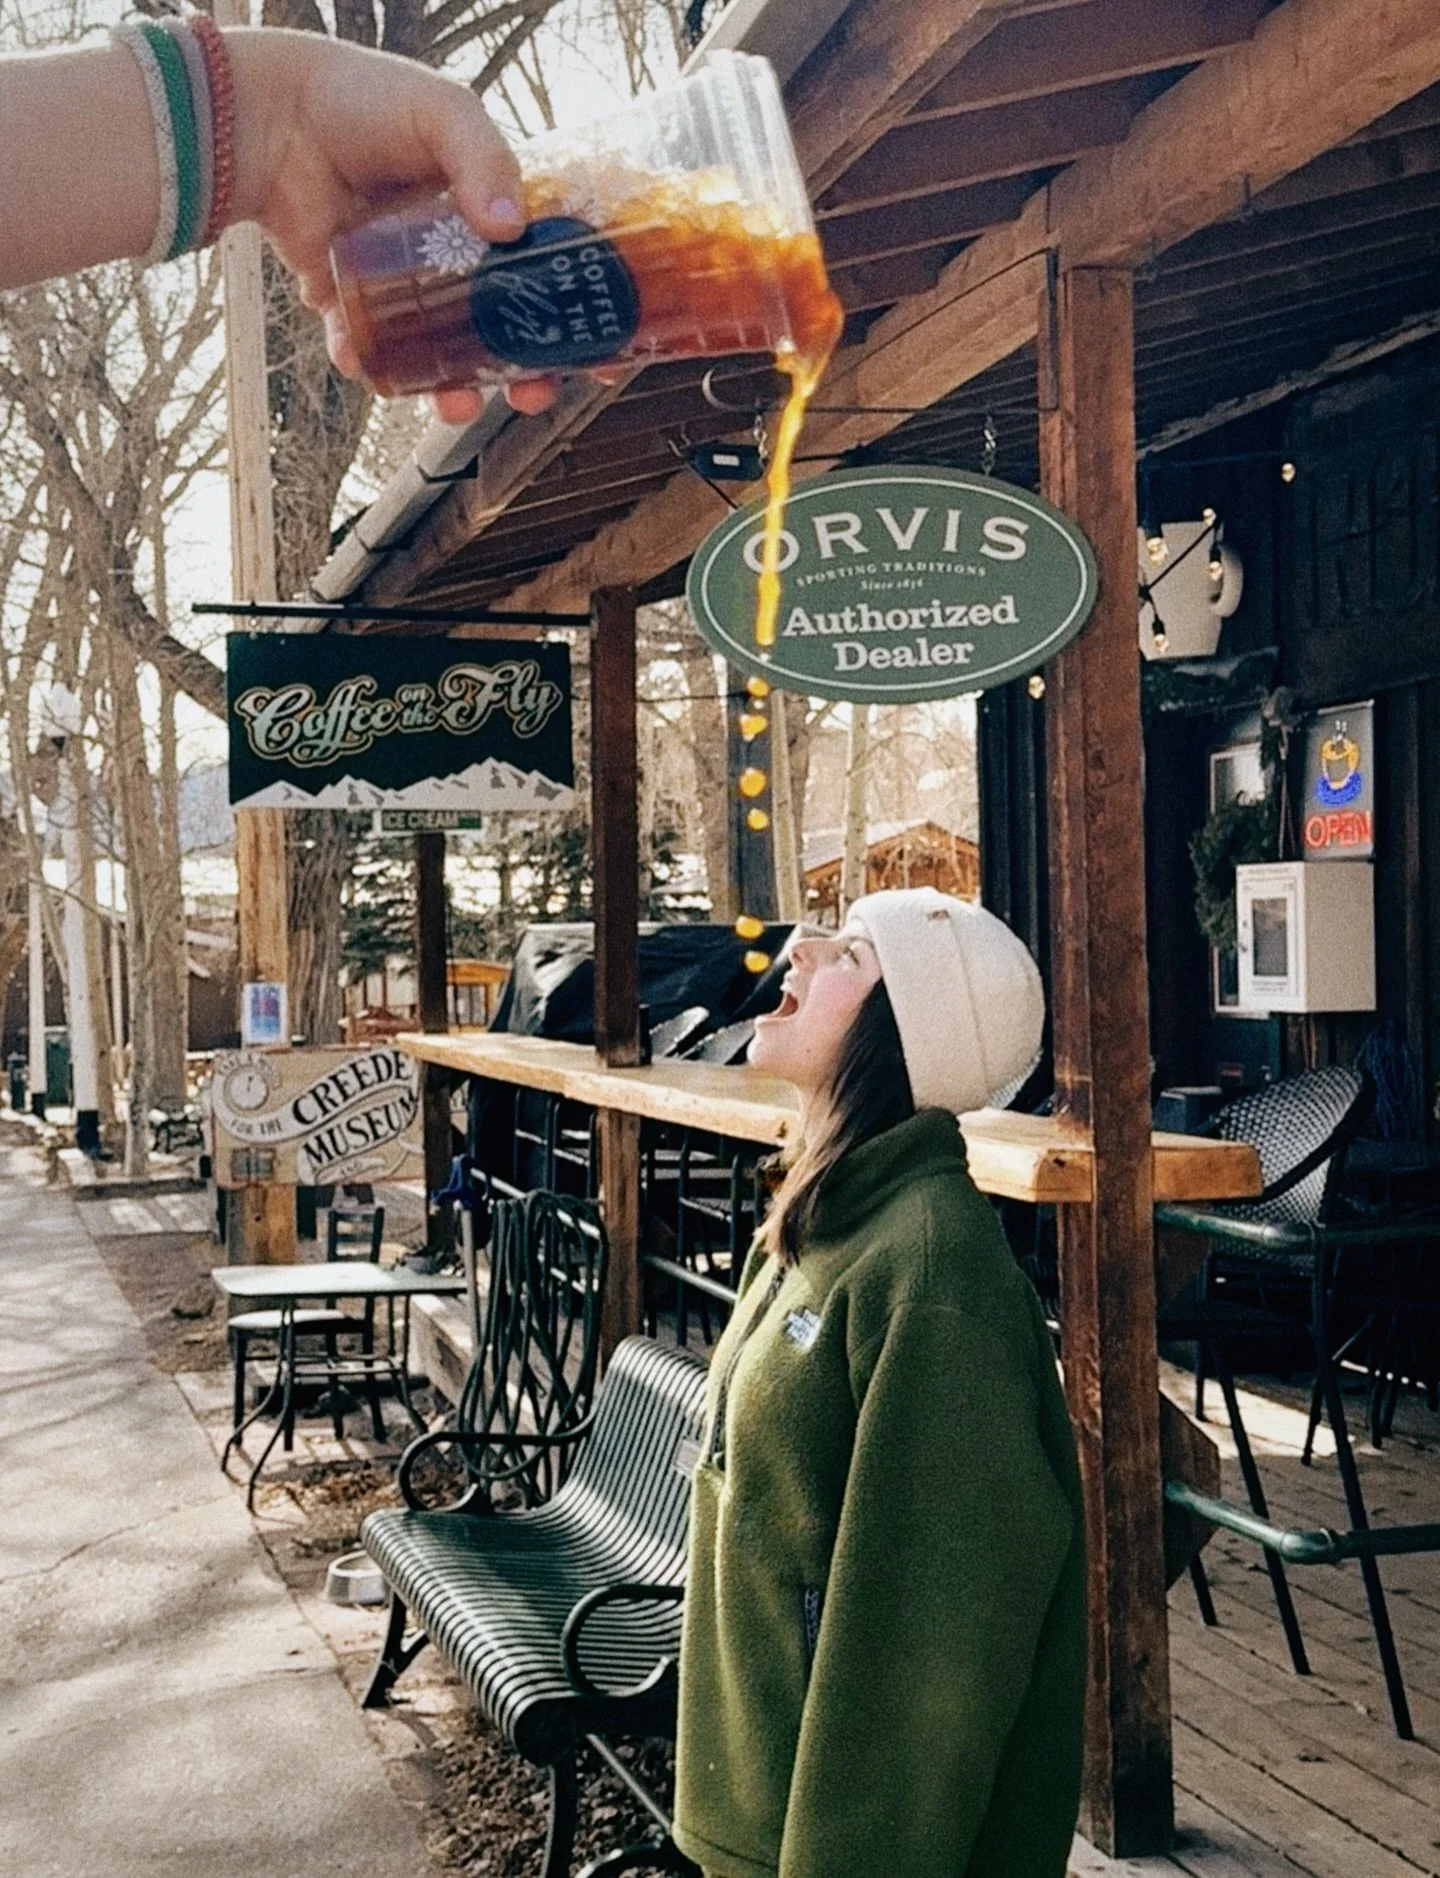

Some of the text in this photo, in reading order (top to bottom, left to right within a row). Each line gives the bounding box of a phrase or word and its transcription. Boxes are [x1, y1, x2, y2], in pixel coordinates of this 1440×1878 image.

[551, 255, 593, 342] ON THE
[580, 247, 620, 337] COFFEE
[743, 508, 1030, 573] ORVIS
[796, 561, 986, 586] SPORTING TRADITIONS
[860, 580, 892, 590] Since
[782, 596, 1020, 637] Authorized
[833, 640, 975, 672] Dealer
[239, 663, 553, 760] Coffee on the Fly
[407, 812, 459, 829] CREAM
[1304, 811, 1372, 849] OPEN
[292, 1050, 412, 1125] CREEDE
[303, 1090, 420, 1173] MUSEUM
